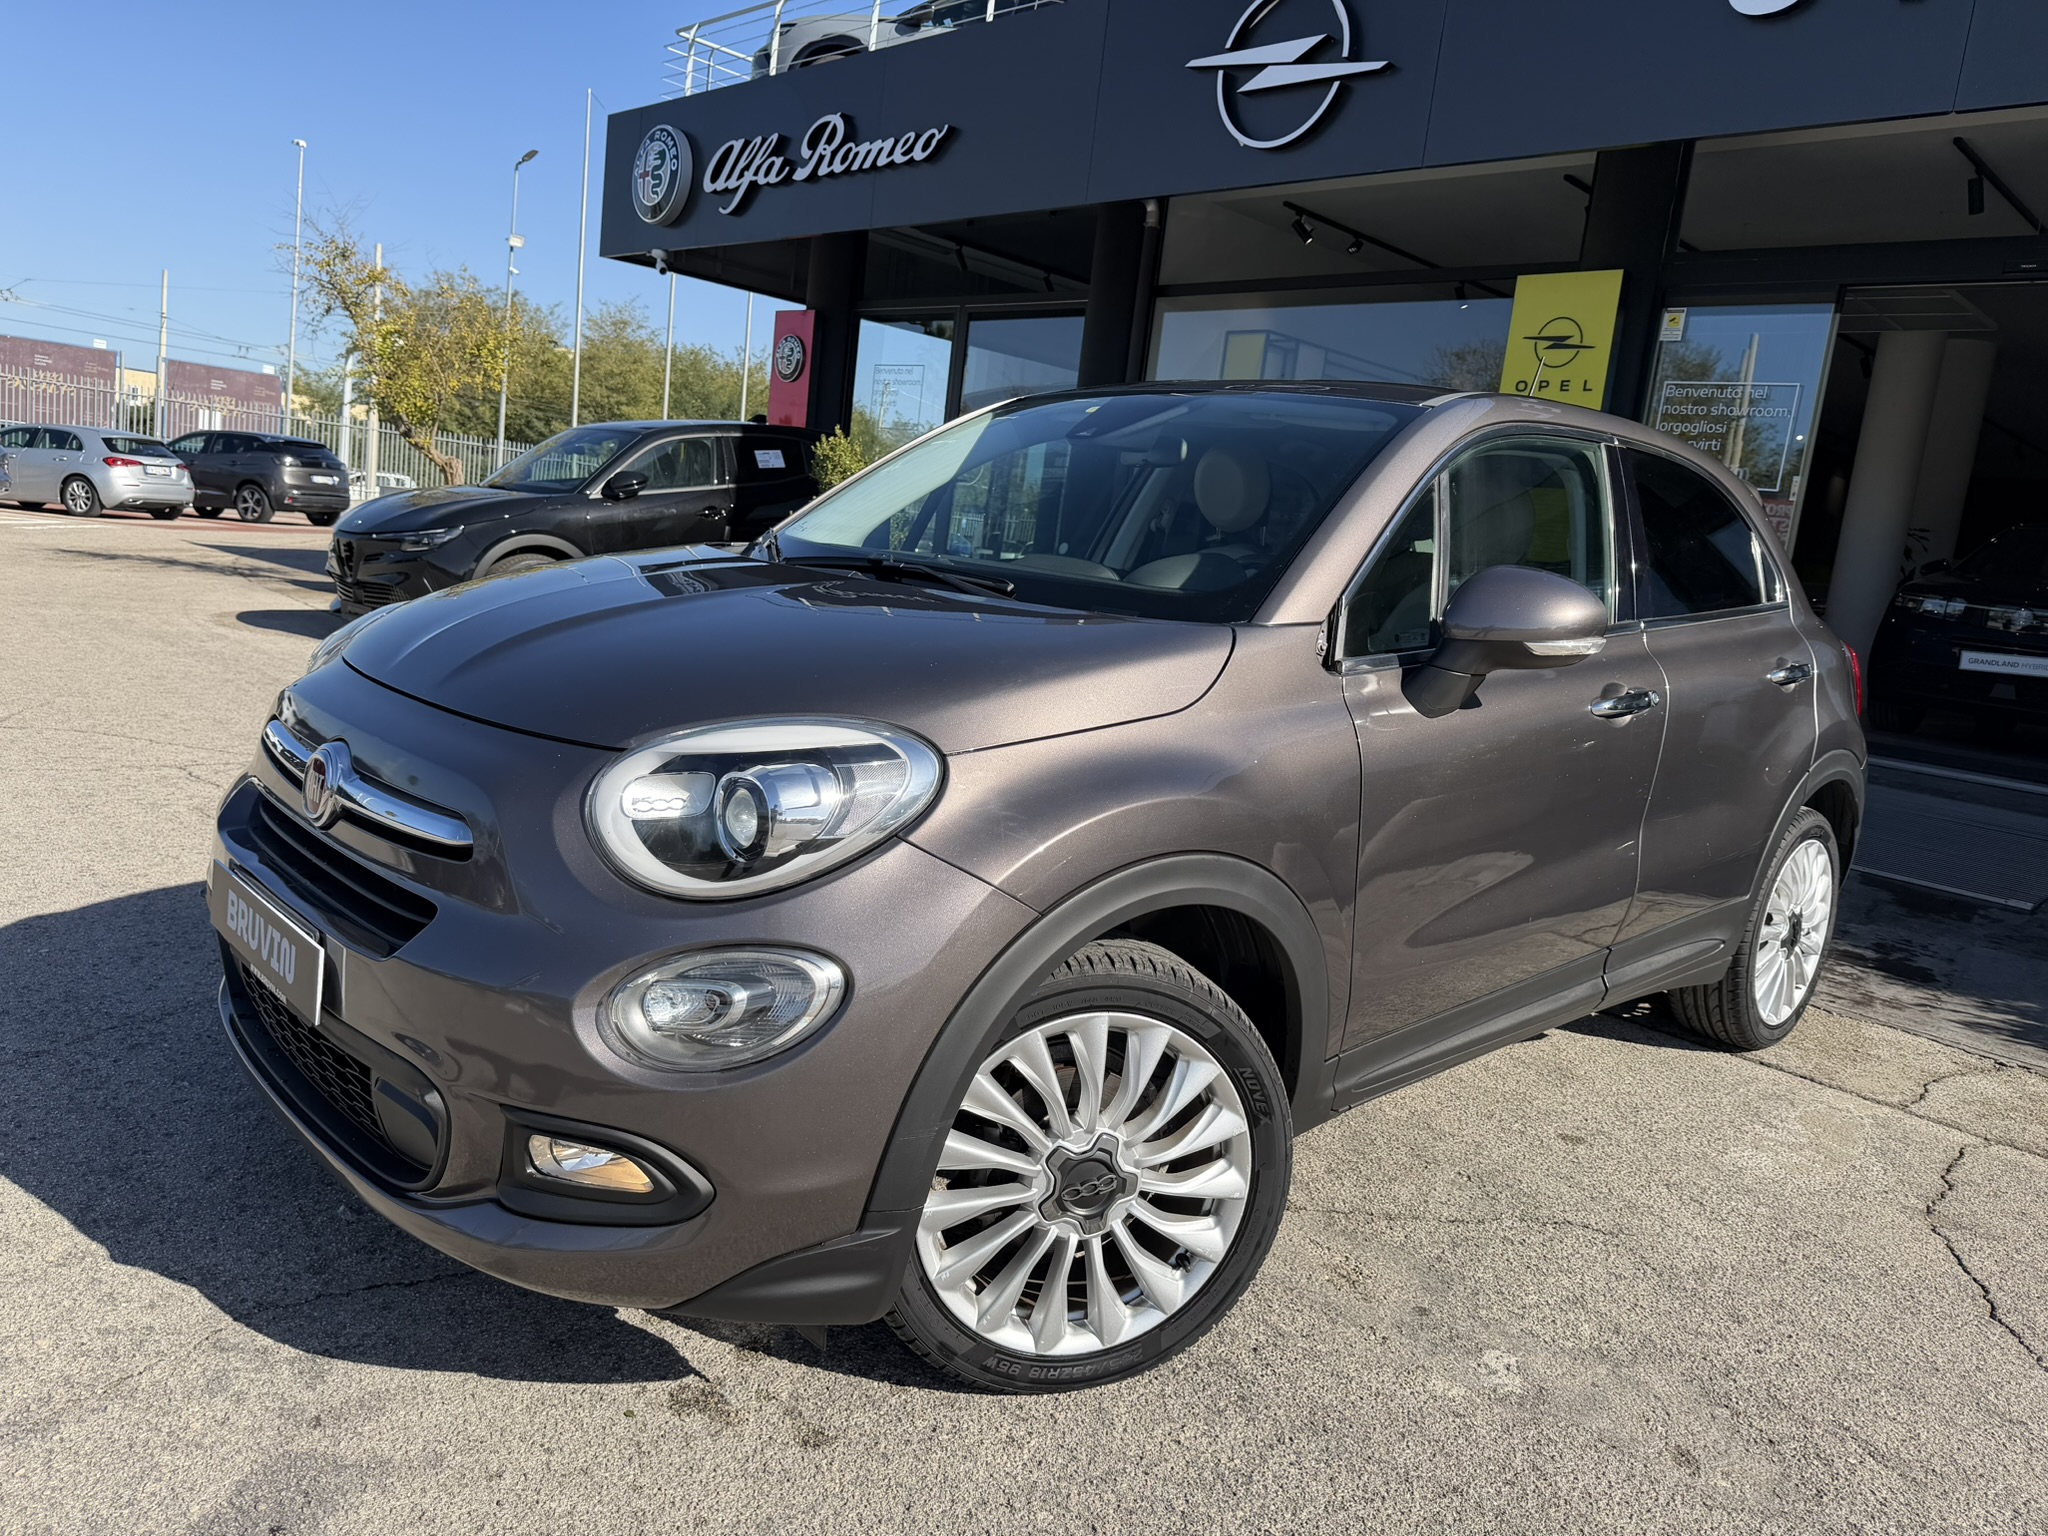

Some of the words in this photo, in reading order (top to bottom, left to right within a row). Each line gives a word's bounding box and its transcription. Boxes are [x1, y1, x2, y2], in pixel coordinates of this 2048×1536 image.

[654, 130, 678, 171] ROMEO
[703, 133, 789, 214] Alfa
[793, 112, 949, 181] Romeo
[1515, 379, 1593, 392] OPEL
[1662, 403, 1707, 416] nostro
[1710, 403, 1792, 418] showroom,
[1660, 420, 1728, 435] orgogliosi
[1968, 657, 2020, 668] GRANDLAND
[226, 888, 297, 985] BRUVIN
[1234, 1067, 1273, 1126] NOVEX
